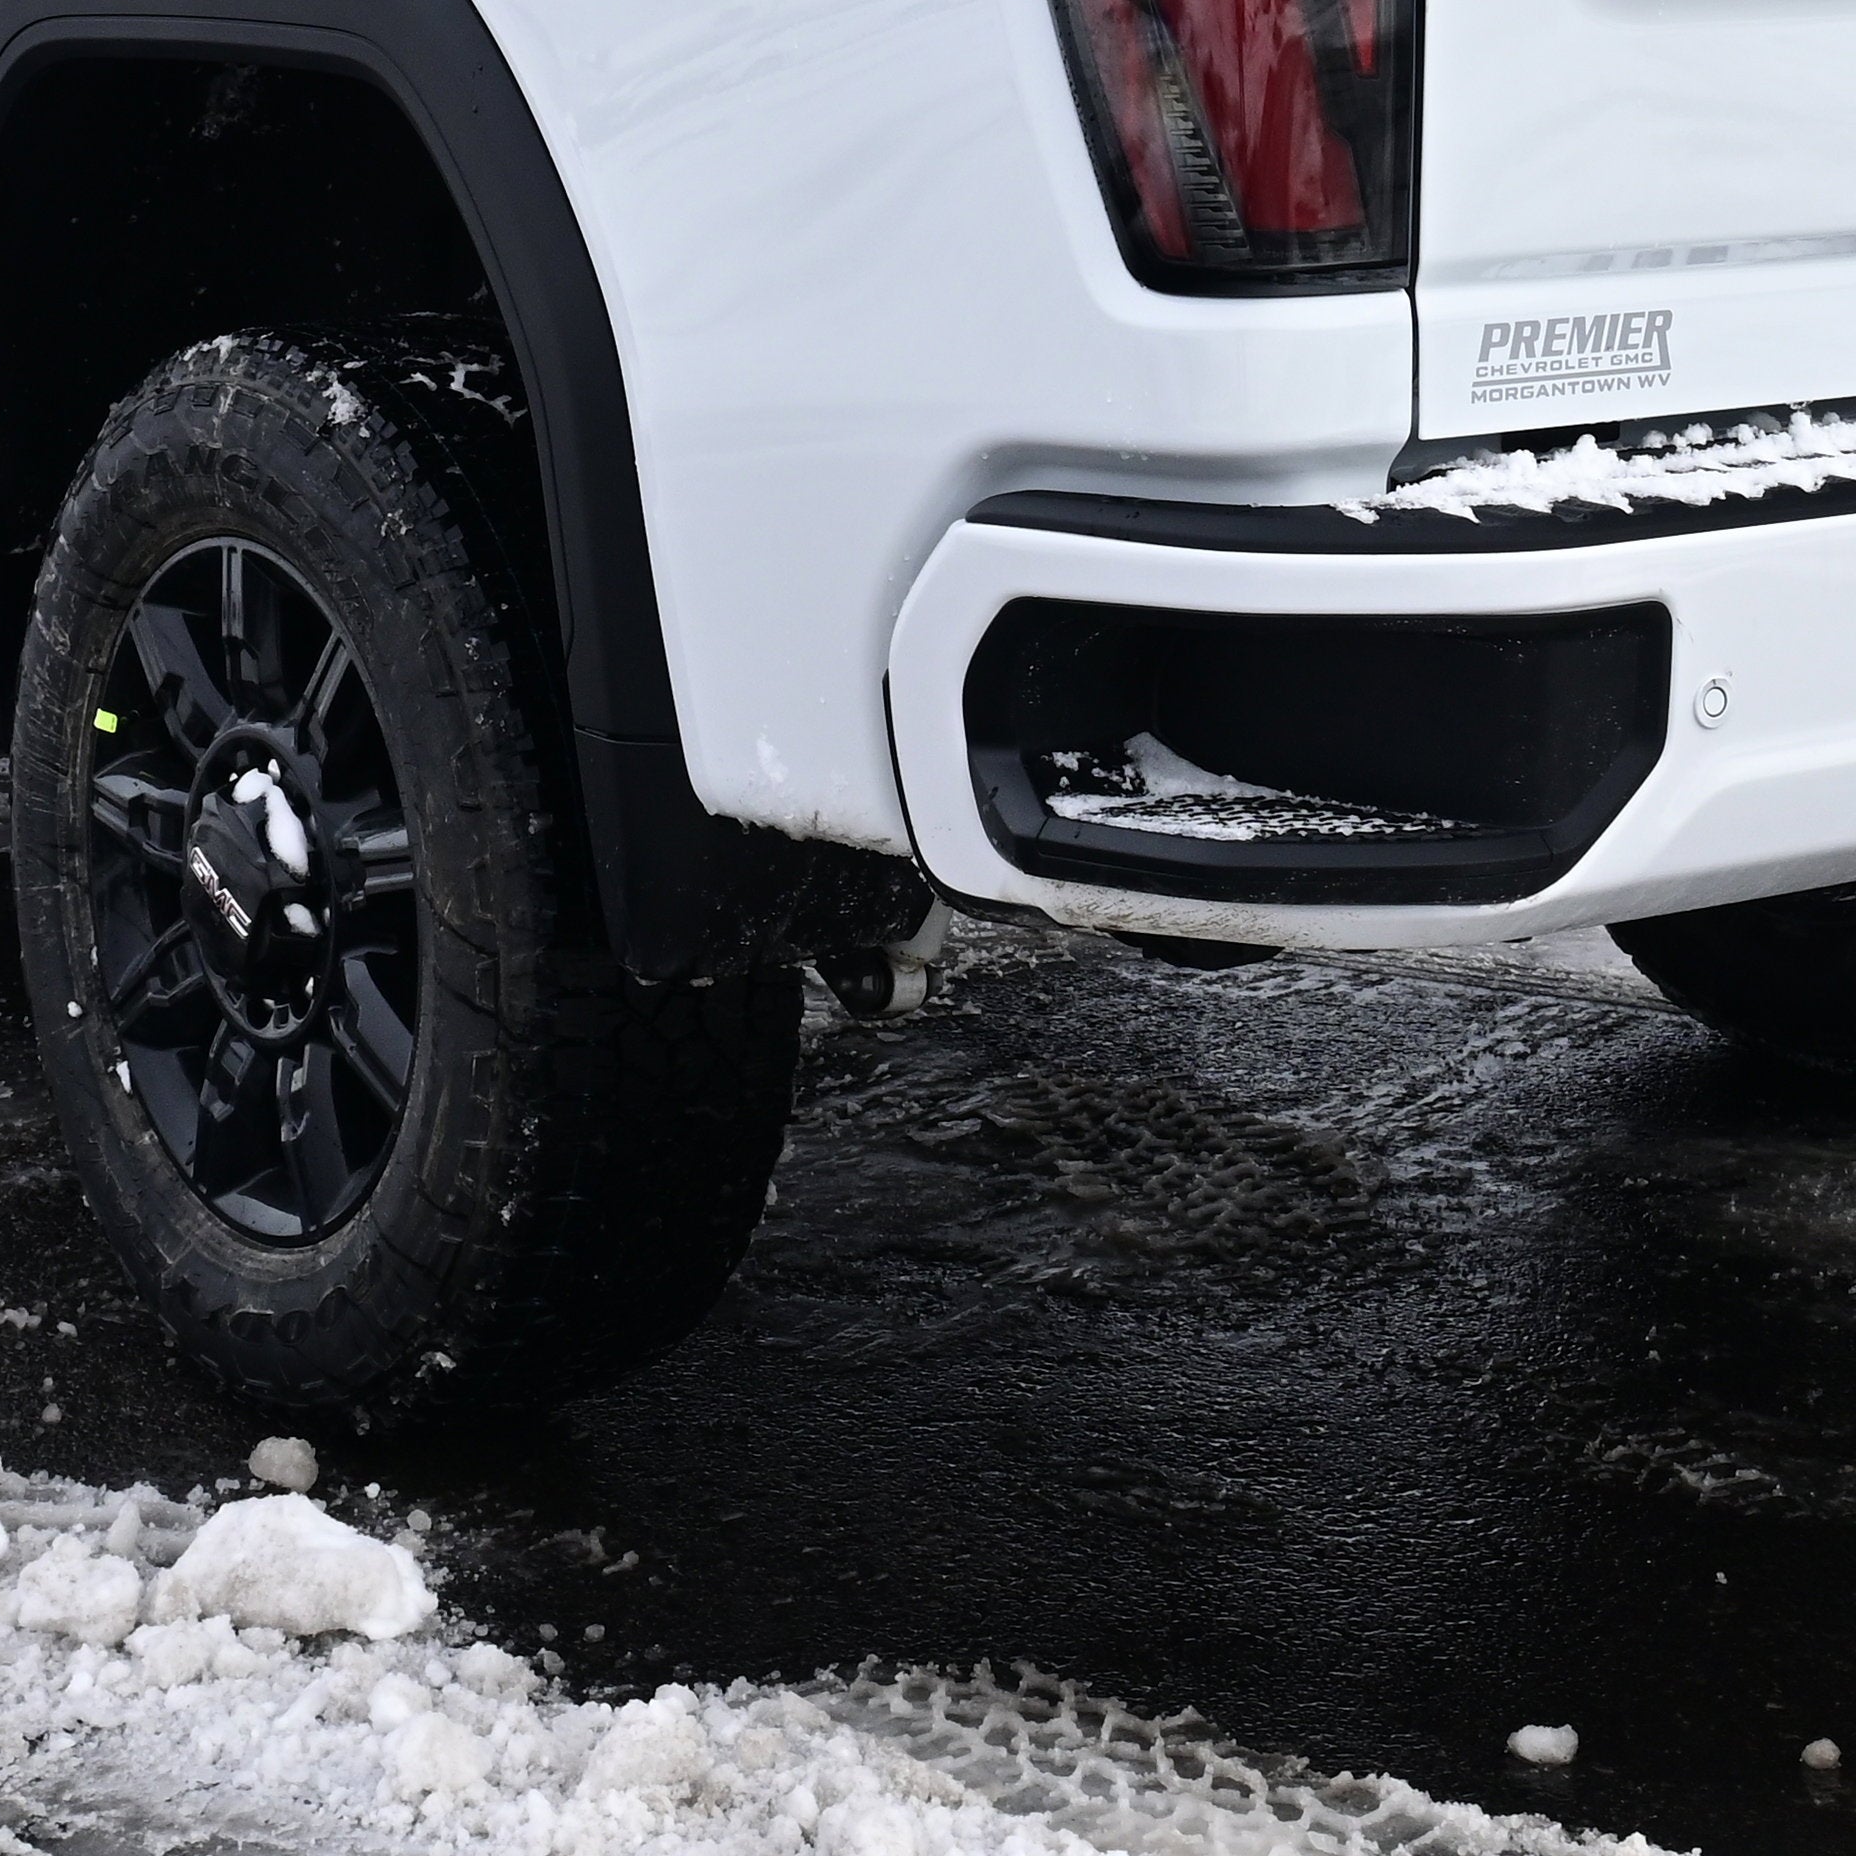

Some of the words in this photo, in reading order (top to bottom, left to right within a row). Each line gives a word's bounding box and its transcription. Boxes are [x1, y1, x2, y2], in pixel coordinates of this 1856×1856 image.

[1478, 309, 1672, 369] PREMIER
[1475, 356, 1603, 378] CHEVROLET
[1610, 352, 1654, 366] GMC
[1471, 376, 1631, 404] MORGANTOWN
[1638, 373, 1672, 388] WV
[190, 846, 252, 939] GMC
